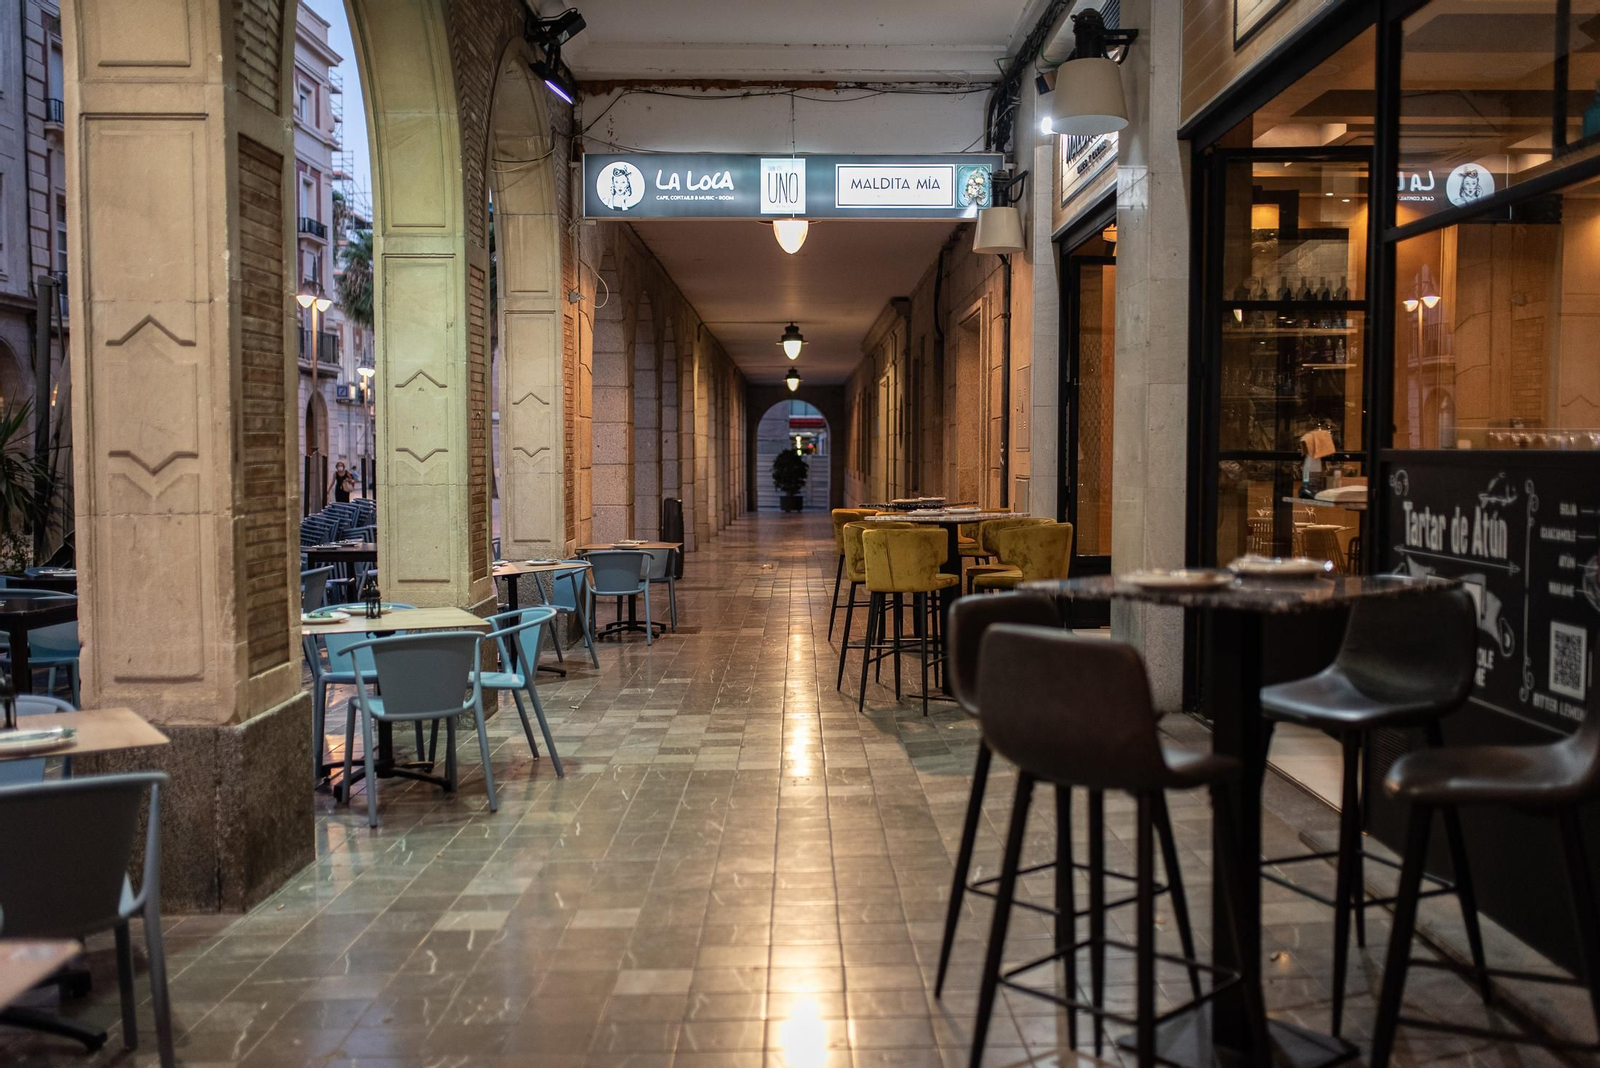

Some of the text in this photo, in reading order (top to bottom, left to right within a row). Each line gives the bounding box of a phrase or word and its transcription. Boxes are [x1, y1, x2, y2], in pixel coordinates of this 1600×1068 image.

[655, 169, 734, 191] LA LOCA
[767, 172, 799, 204] UNO
[850, 175, 941, 190] MALDITA MÍA
[1402, 500, 1508, 559] Tartar de Atún
